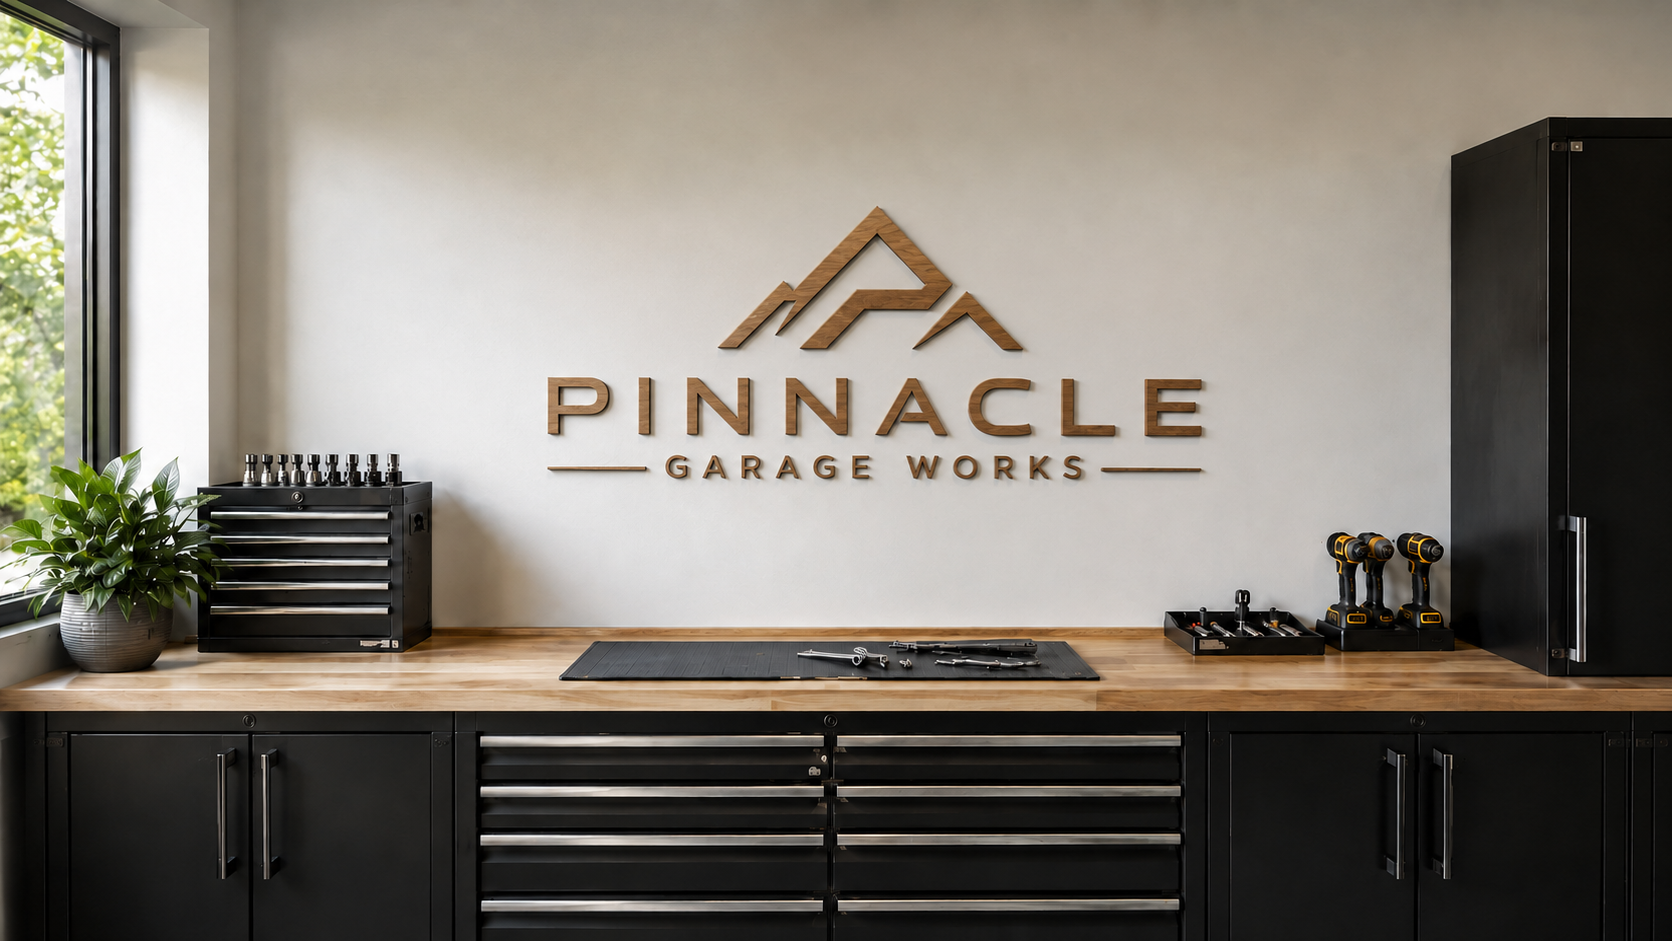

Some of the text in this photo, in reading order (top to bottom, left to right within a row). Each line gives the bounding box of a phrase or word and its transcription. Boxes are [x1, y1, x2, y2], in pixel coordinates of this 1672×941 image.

[547, 377, 1204, 437] PINNACLE
[665, 455, 1083, 479] GARAGE WORKS
